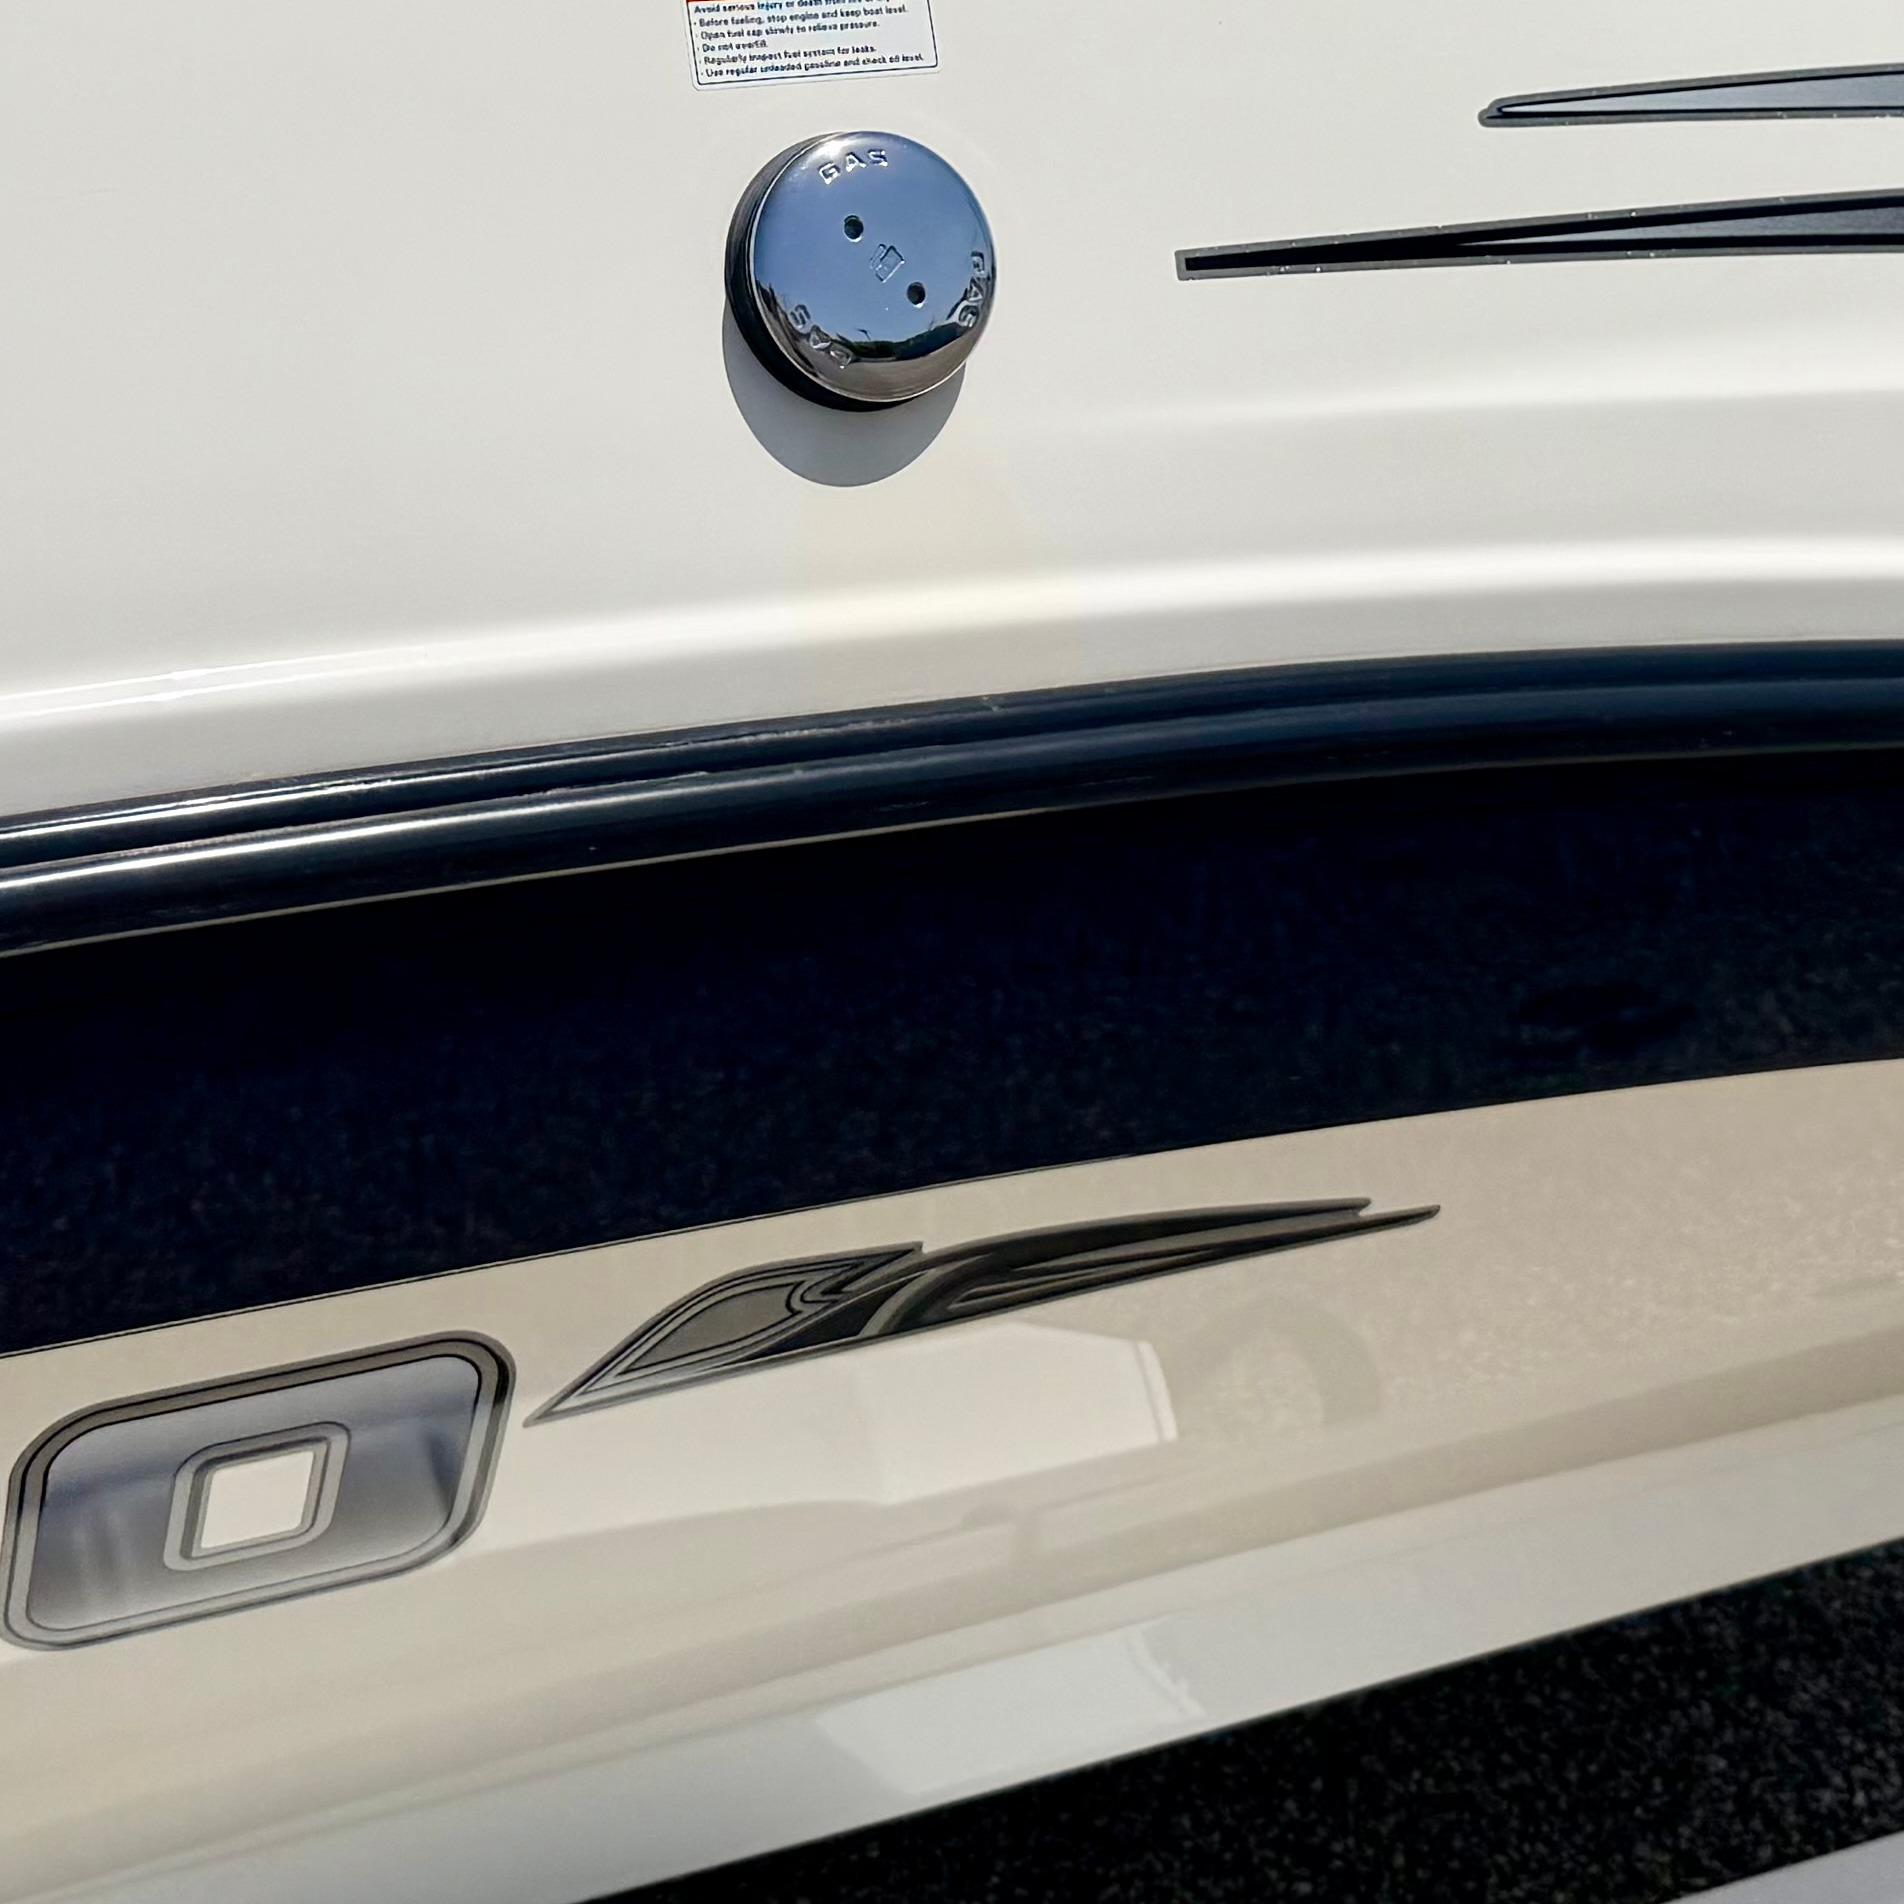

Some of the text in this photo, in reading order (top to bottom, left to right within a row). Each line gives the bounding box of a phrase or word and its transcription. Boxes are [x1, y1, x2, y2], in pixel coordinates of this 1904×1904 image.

[694, 4, 720, 13] Avoid
[757, 1, 783, 11] injury
[789, 11, 819, 22] engine
[817, 148, 889, 185] GAS
